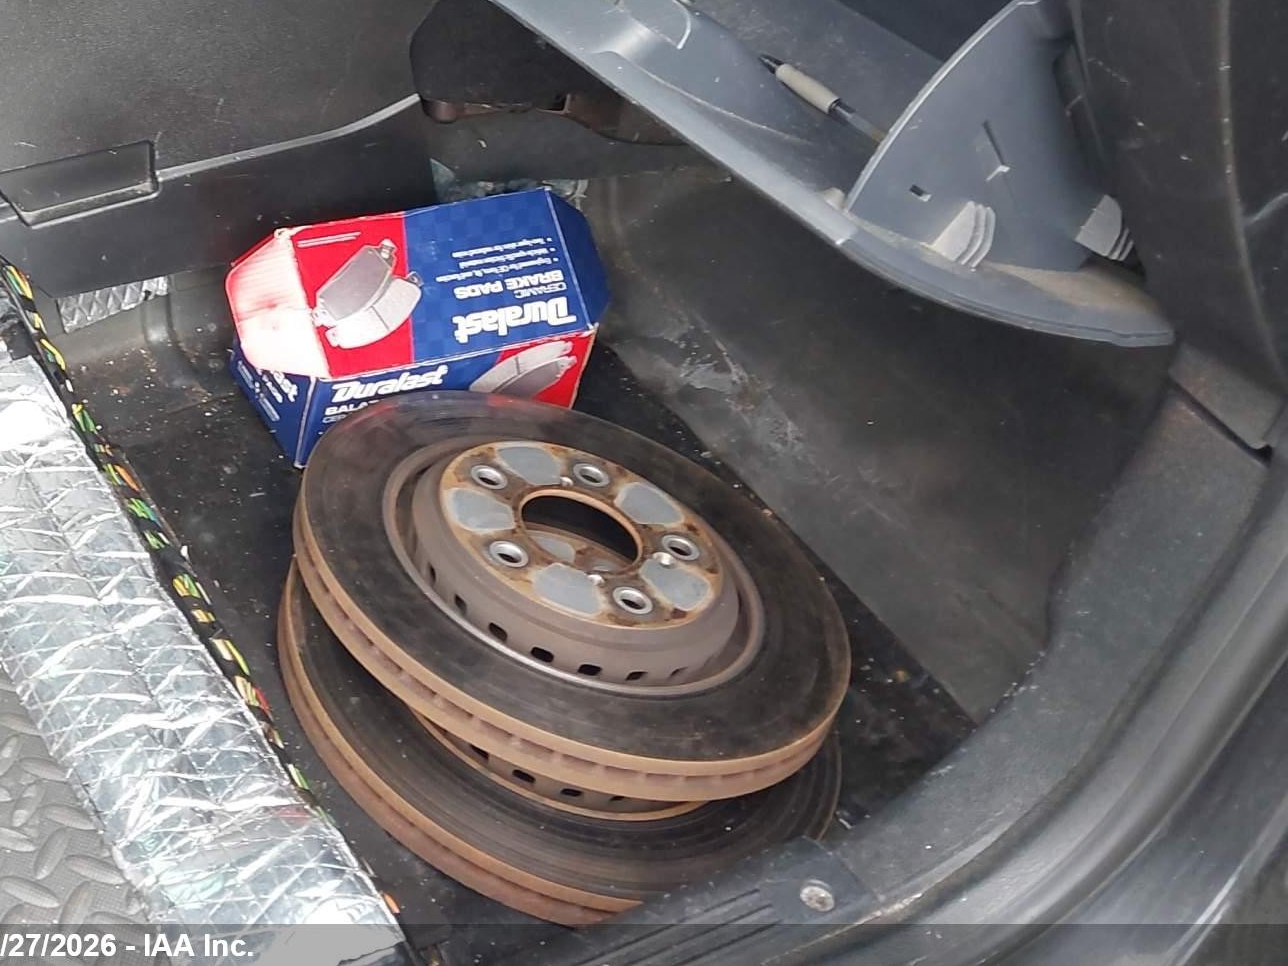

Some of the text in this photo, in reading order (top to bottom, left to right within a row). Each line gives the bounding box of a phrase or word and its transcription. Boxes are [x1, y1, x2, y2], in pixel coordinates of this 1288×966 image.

[453, 280, 504, 300] PADS
[505, 269, 565, 291] BRAKE
[514, 282, 567, 299] CERAMIC
[452, 296, 577, 344] Duralast
[331, 364, 449, 403] Duralast
